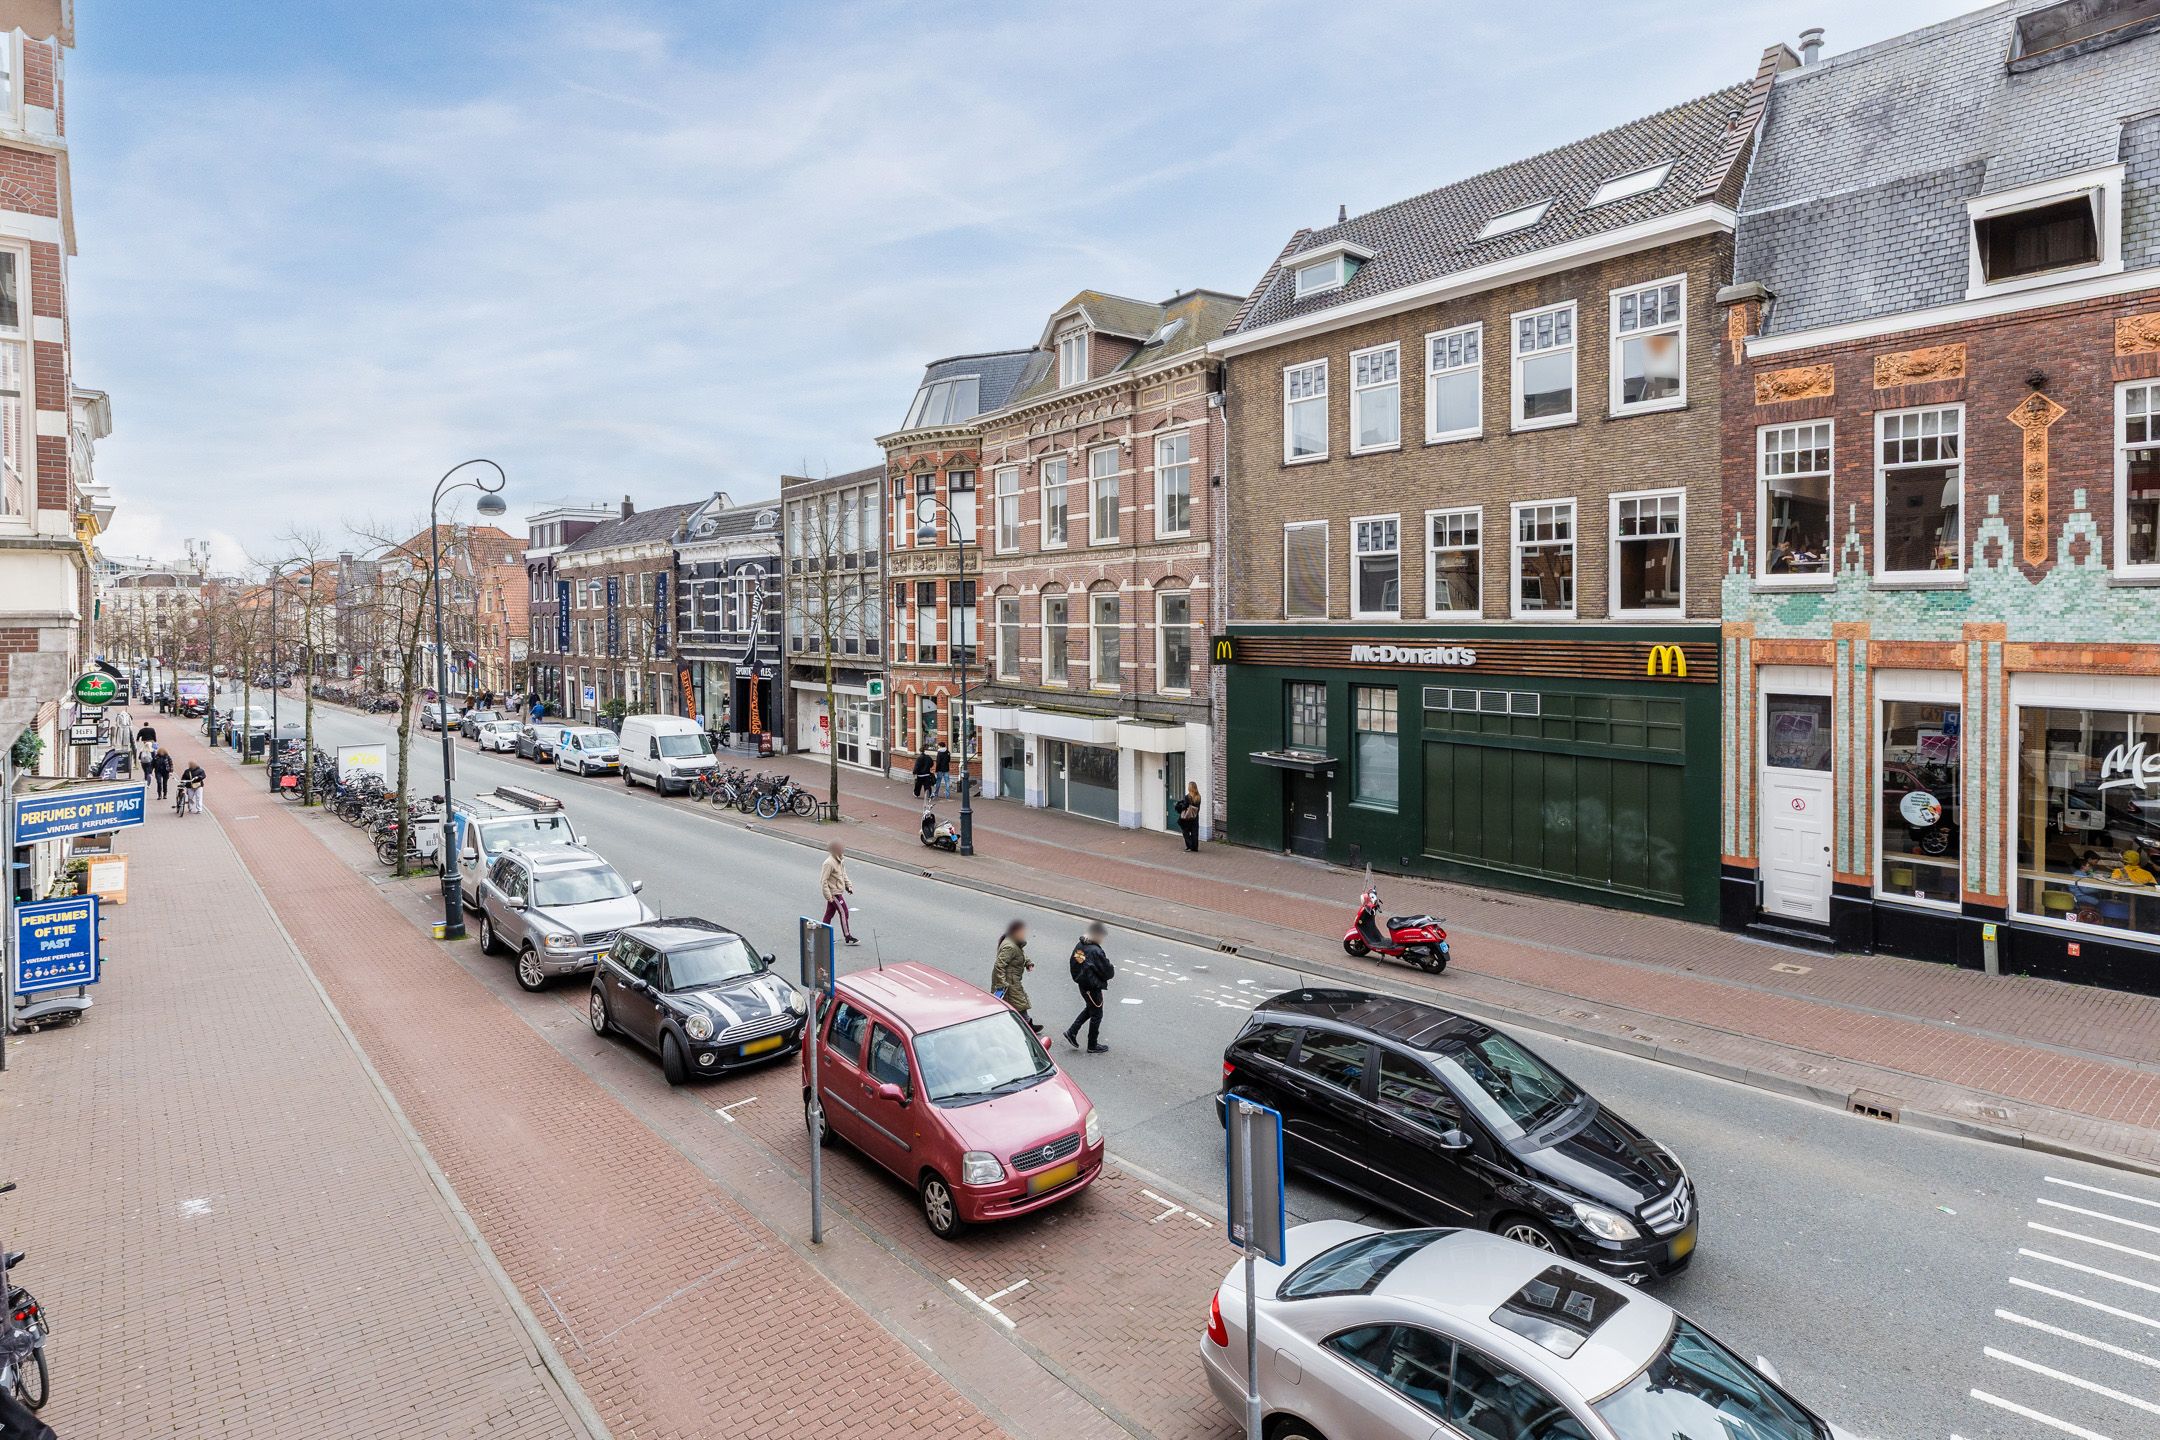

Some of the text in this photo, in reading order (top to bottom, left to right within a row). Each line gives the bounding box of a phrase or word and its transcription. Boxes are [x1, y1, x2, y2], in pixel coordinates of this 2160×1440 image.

[1350, 645, 1477, 665] McDonald's
[21, 798, 141, 825] PERFUMES OF THE PAST
[47, 817, 118, 834] VINTAGE PERFUMES
[21, 910, 88, 927] PERFUMES
[34, 924, 77, 938] OF THE
[40, 938, 72, 951] PAST
[26, 952, 84, 964] VINTAGE PERFUMES
